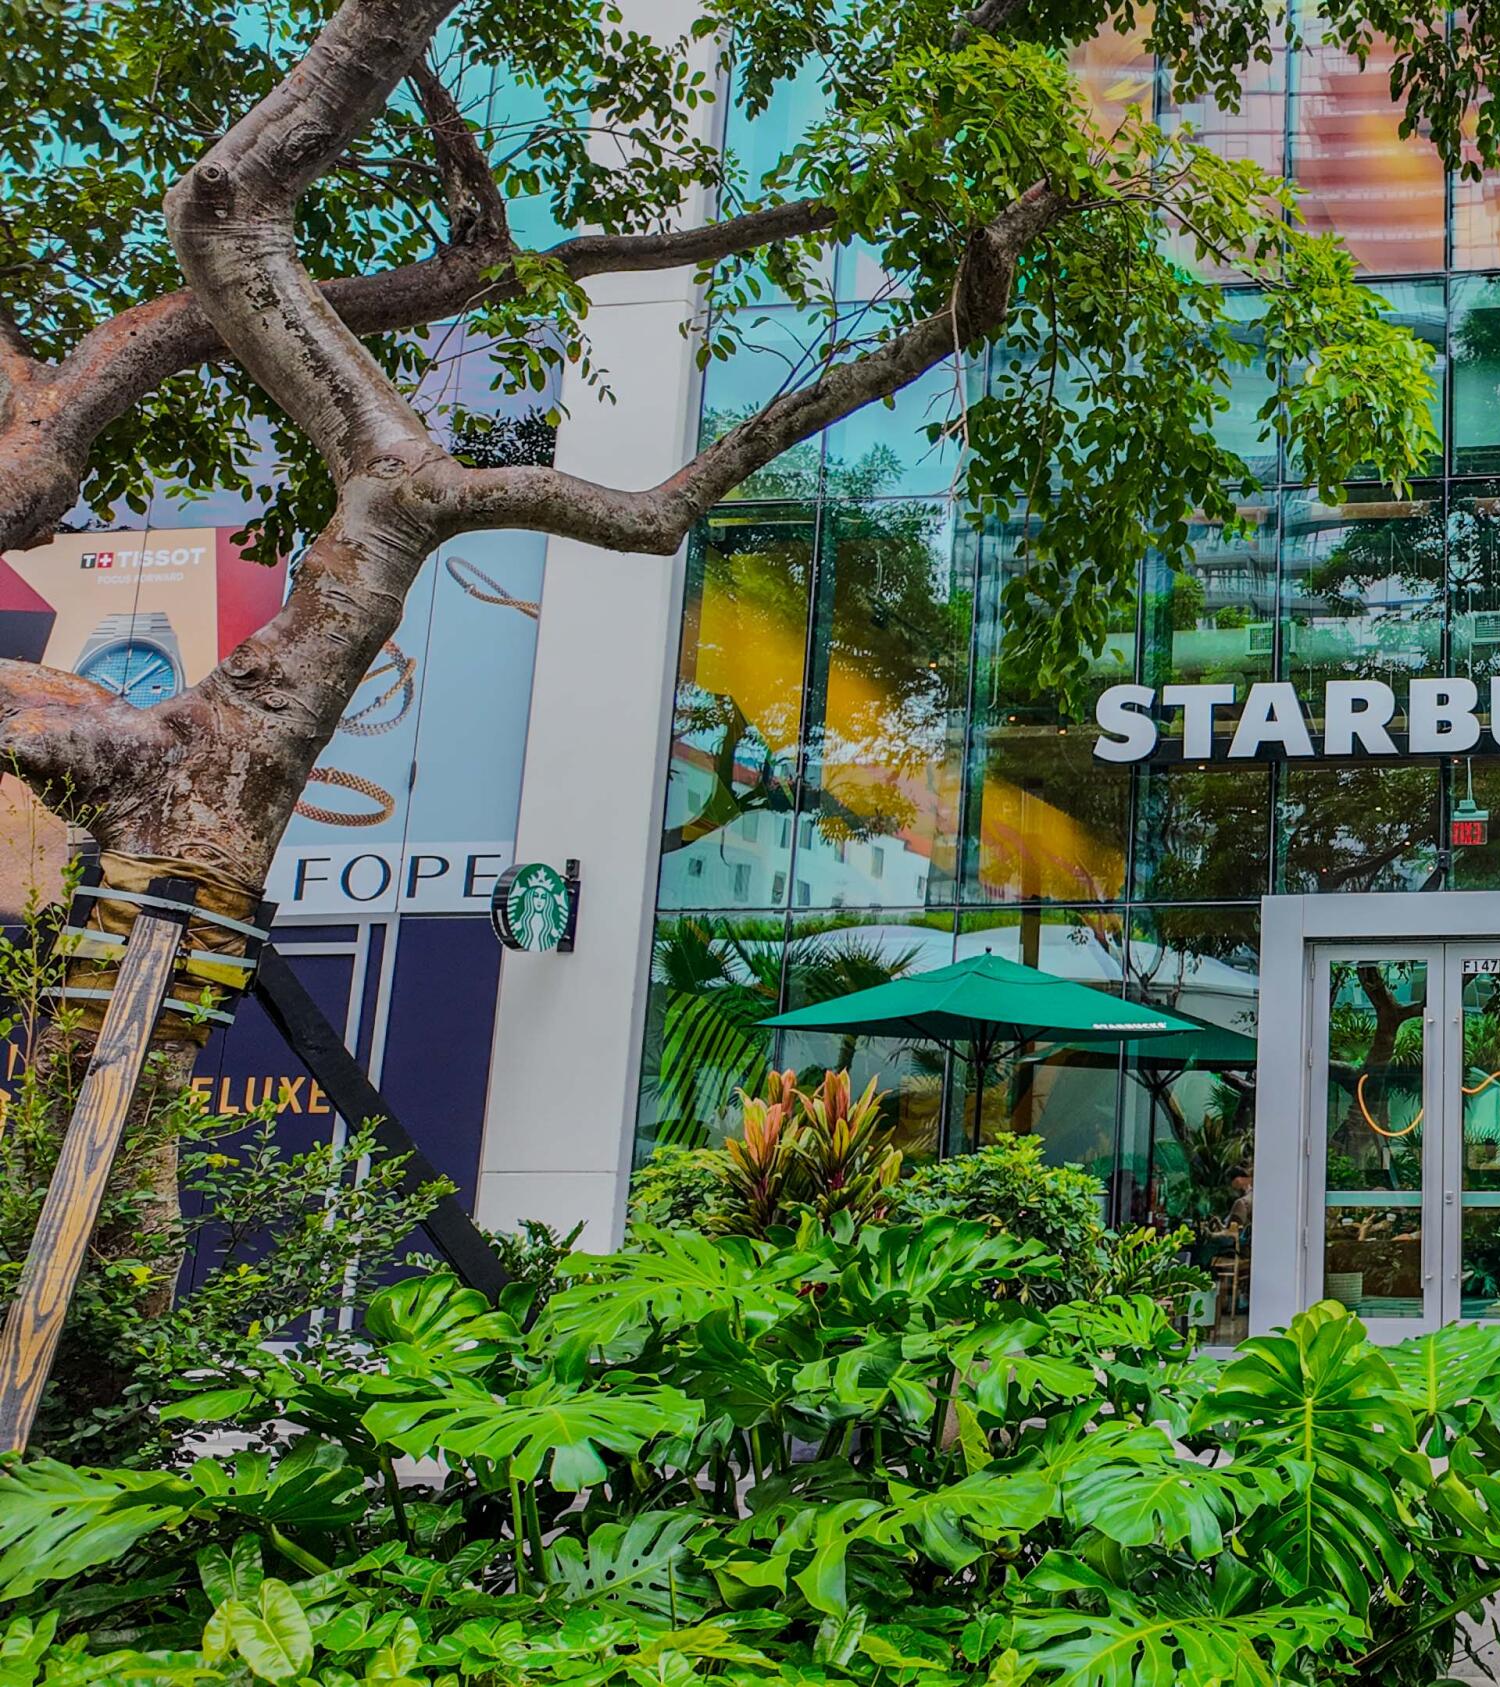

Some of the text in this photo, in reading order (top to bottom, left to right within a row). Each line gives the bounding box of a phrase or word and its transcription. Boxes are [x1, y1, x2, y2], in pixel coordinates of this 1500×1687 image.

[117, 547, 206, 568] TISSOT
[97, 572, 184, 585] FOCUS FORWARD
[293, 854, 502, 901] FOPE
[1463, 960, 1498, 972] F147
[189, 1076, 331, 1115] ELUXE
